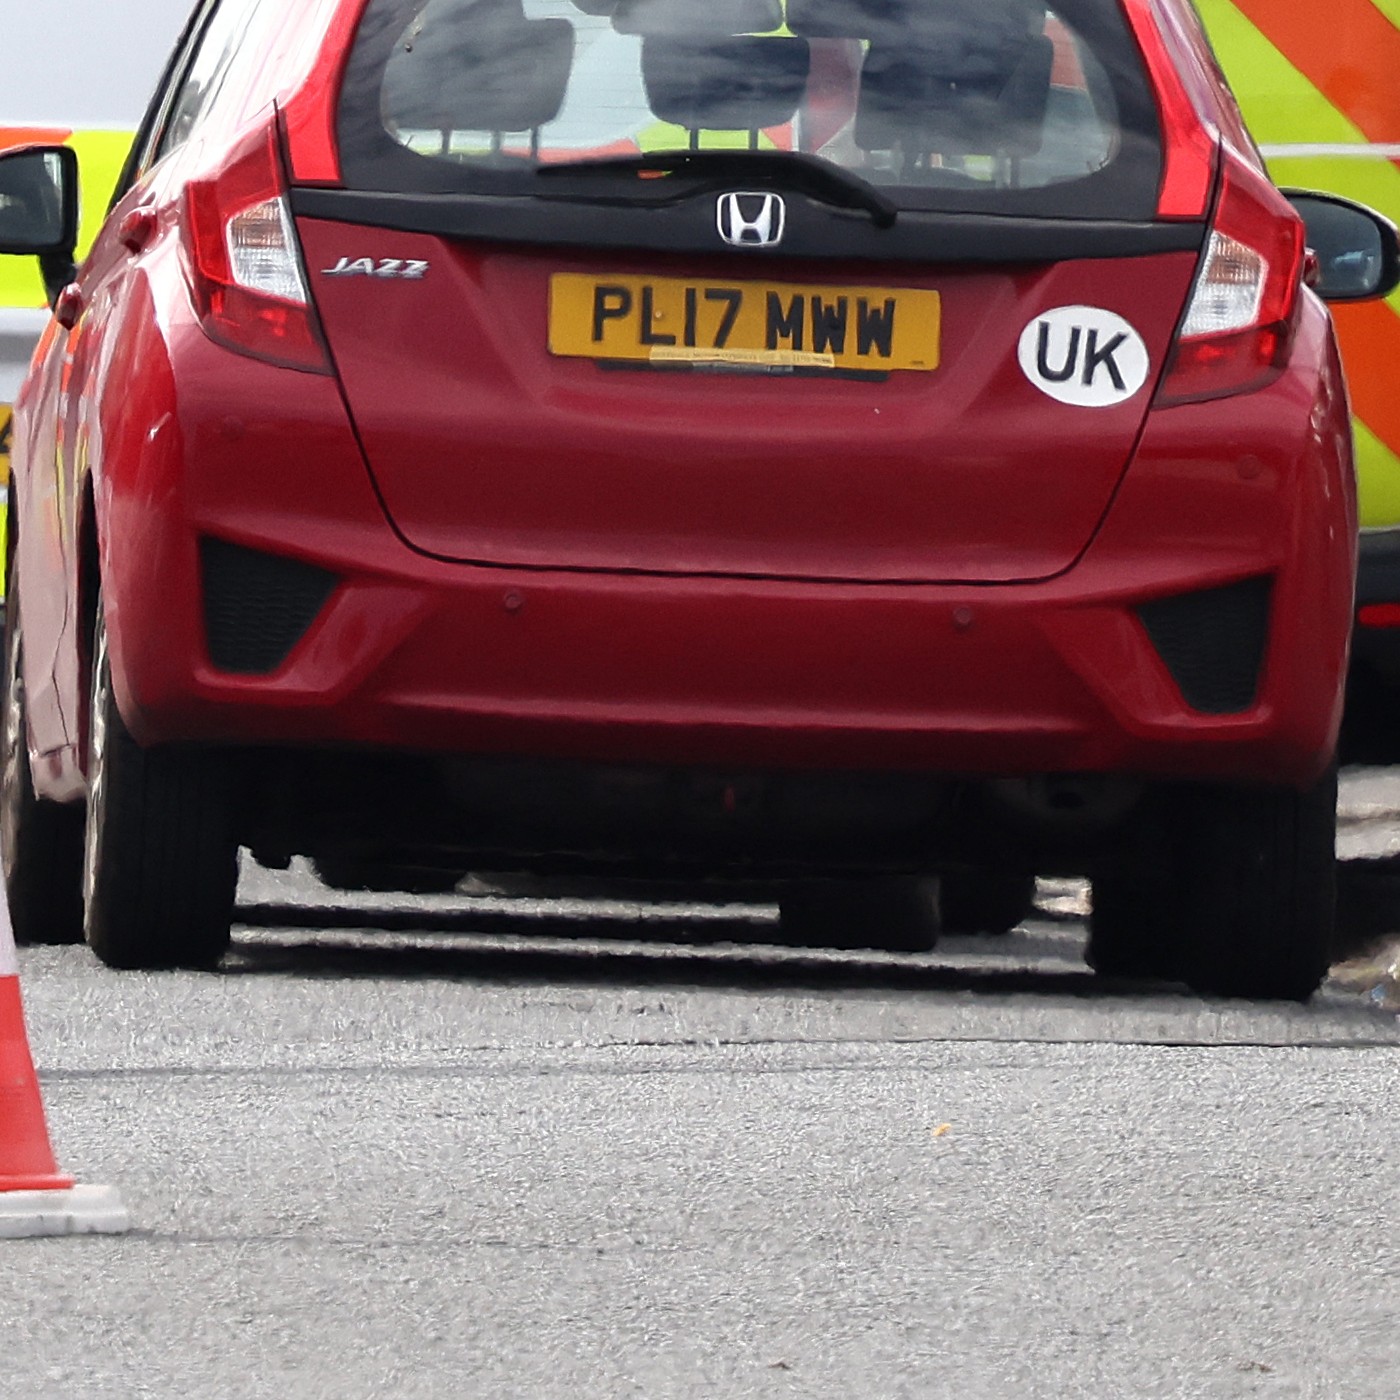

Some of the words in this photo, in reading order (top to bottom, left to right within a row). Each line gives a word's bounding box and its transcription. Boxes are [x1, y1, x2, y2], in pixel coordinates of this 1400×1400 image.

[320, 256, 429, 279] JAZZ
[592, 285, 744, 348] PL17
[766, 291, 896, 357] MWW
[1036, 320, 1128, 391] UK
